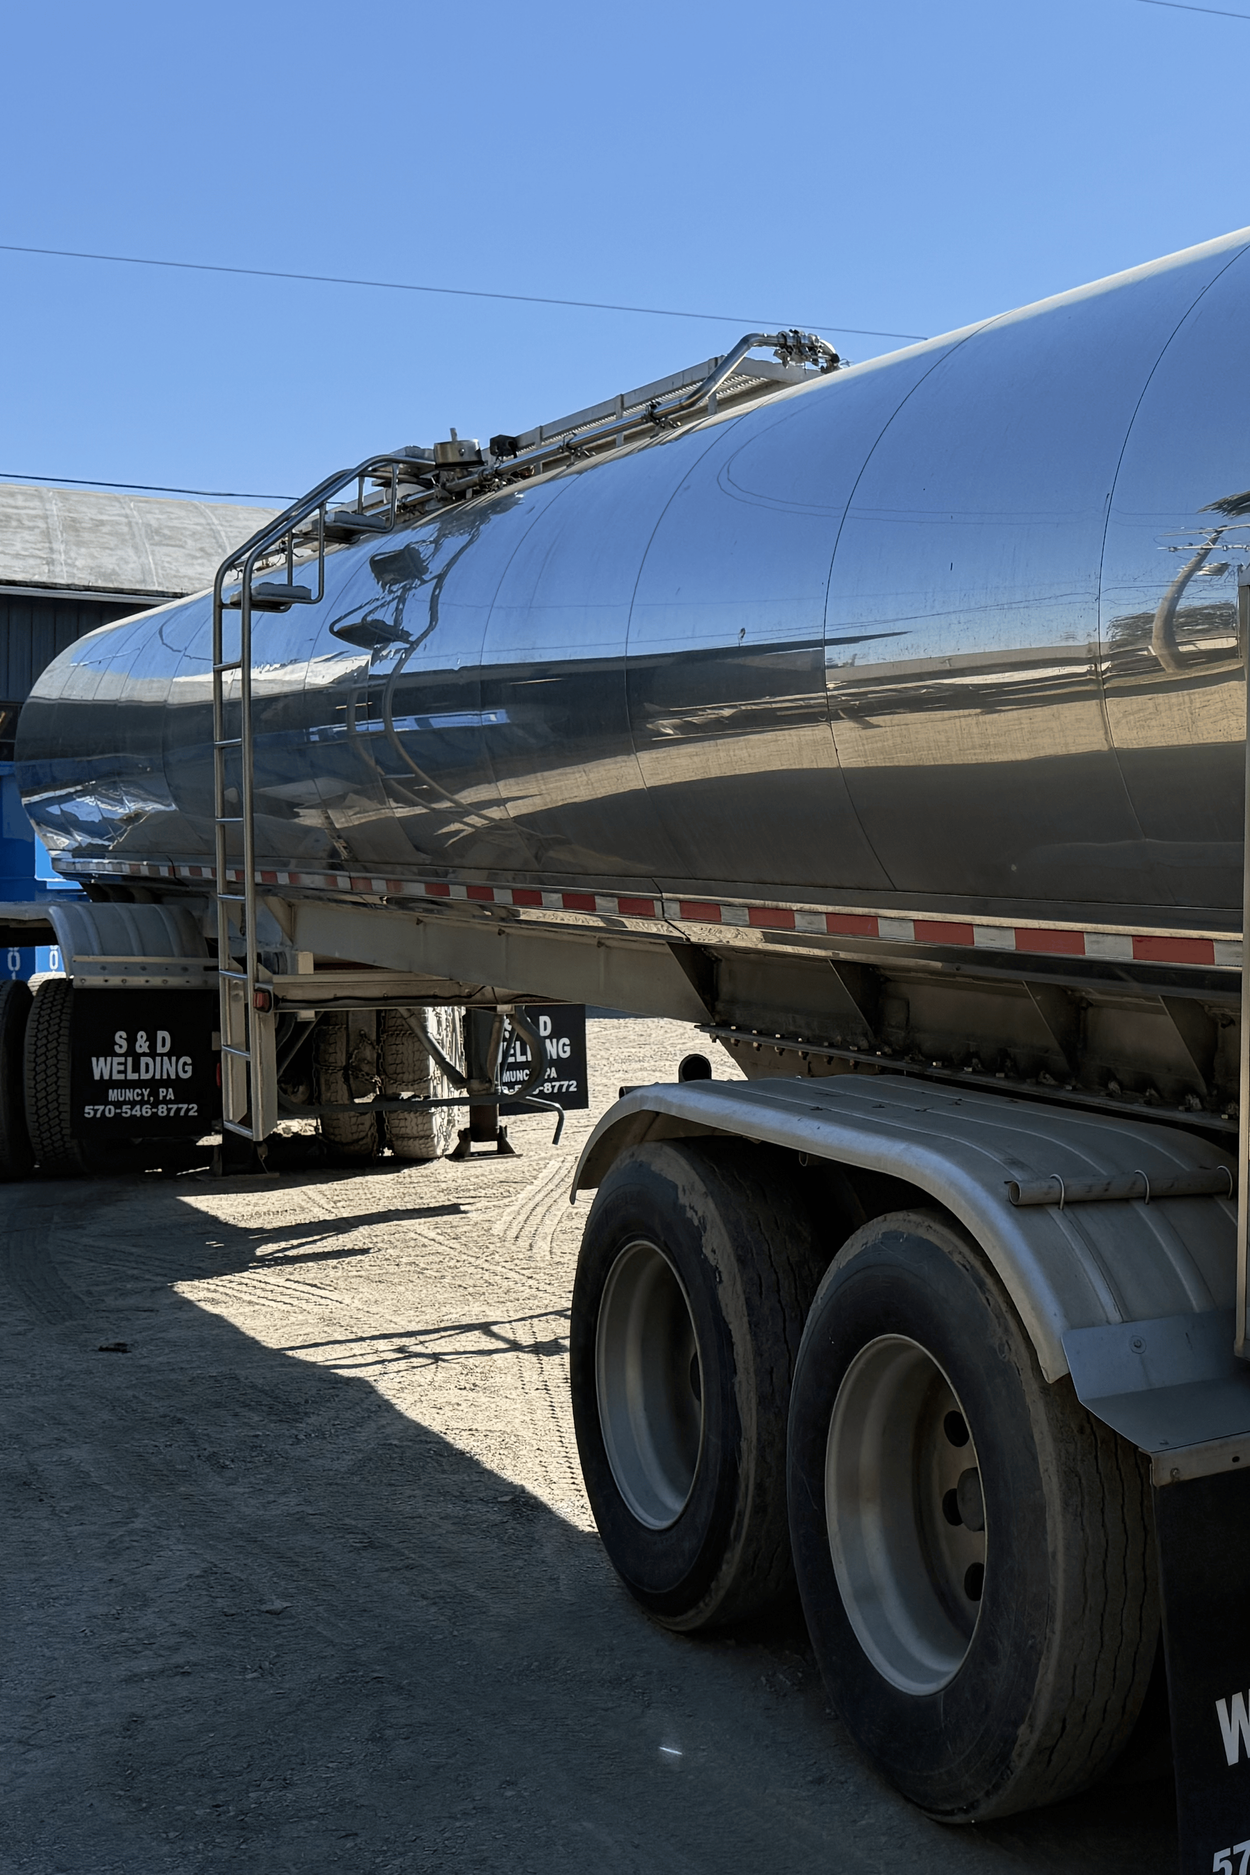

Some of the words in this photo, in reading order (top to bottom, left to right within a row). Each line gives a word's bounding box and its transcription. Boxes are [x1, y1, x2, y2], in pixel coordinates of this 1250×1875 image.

[539, 1015, 552, 1037] D
[114, 1030, 128, 1054] S
[135, 1030, 150, 1053] &
[156, 1030, 171, 1053] D
[91, 1056, 193, 1080] WELDING
[108, 1088, 154, 1103] MUNCY,
[159, 1088, 175, 1100] PA
[84, 1104, 198, 1118] 570-546-8772
